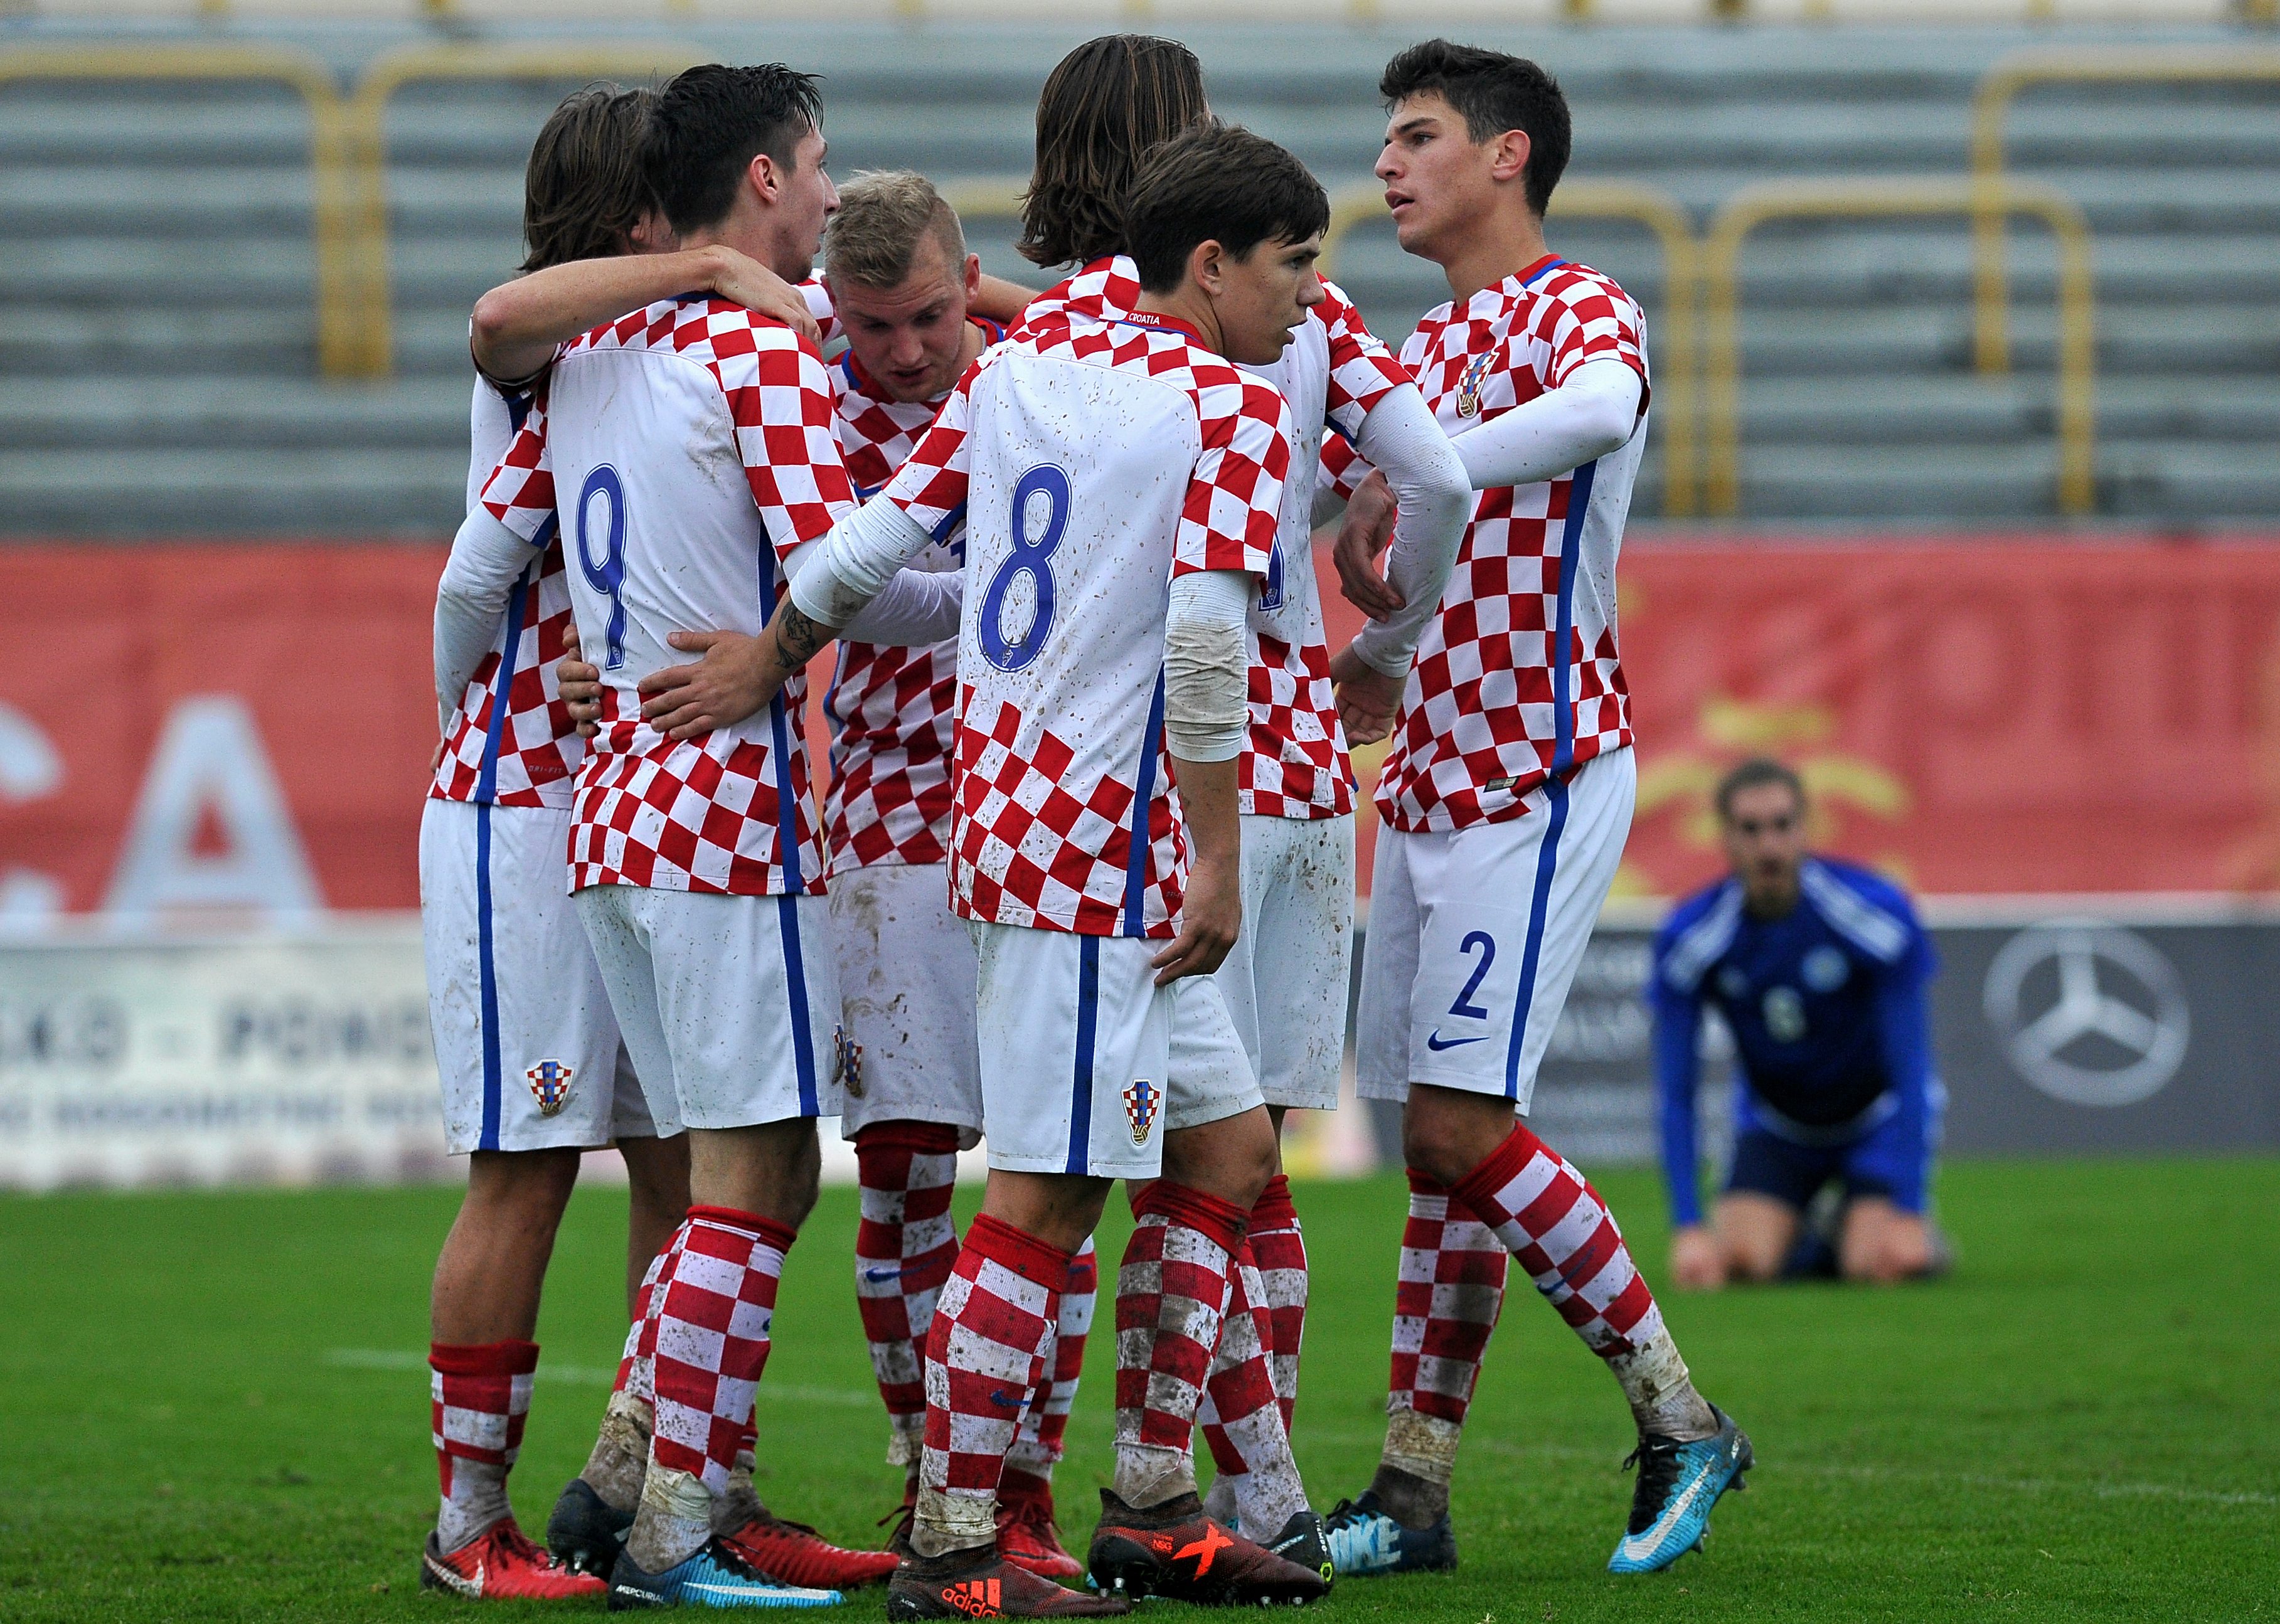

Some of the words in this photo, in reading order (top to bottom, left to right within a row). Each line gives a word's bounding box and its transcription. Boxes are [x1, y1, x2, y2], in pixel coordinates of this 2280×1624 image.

[1127, 312, 1161, 326] CROATIA
[575, 462, 628, 671] 9
[978, 462, 1072, 673] 8
[1448, 930, 1496, 1019] 2
[942, 1588, 1005, 1618] adida
